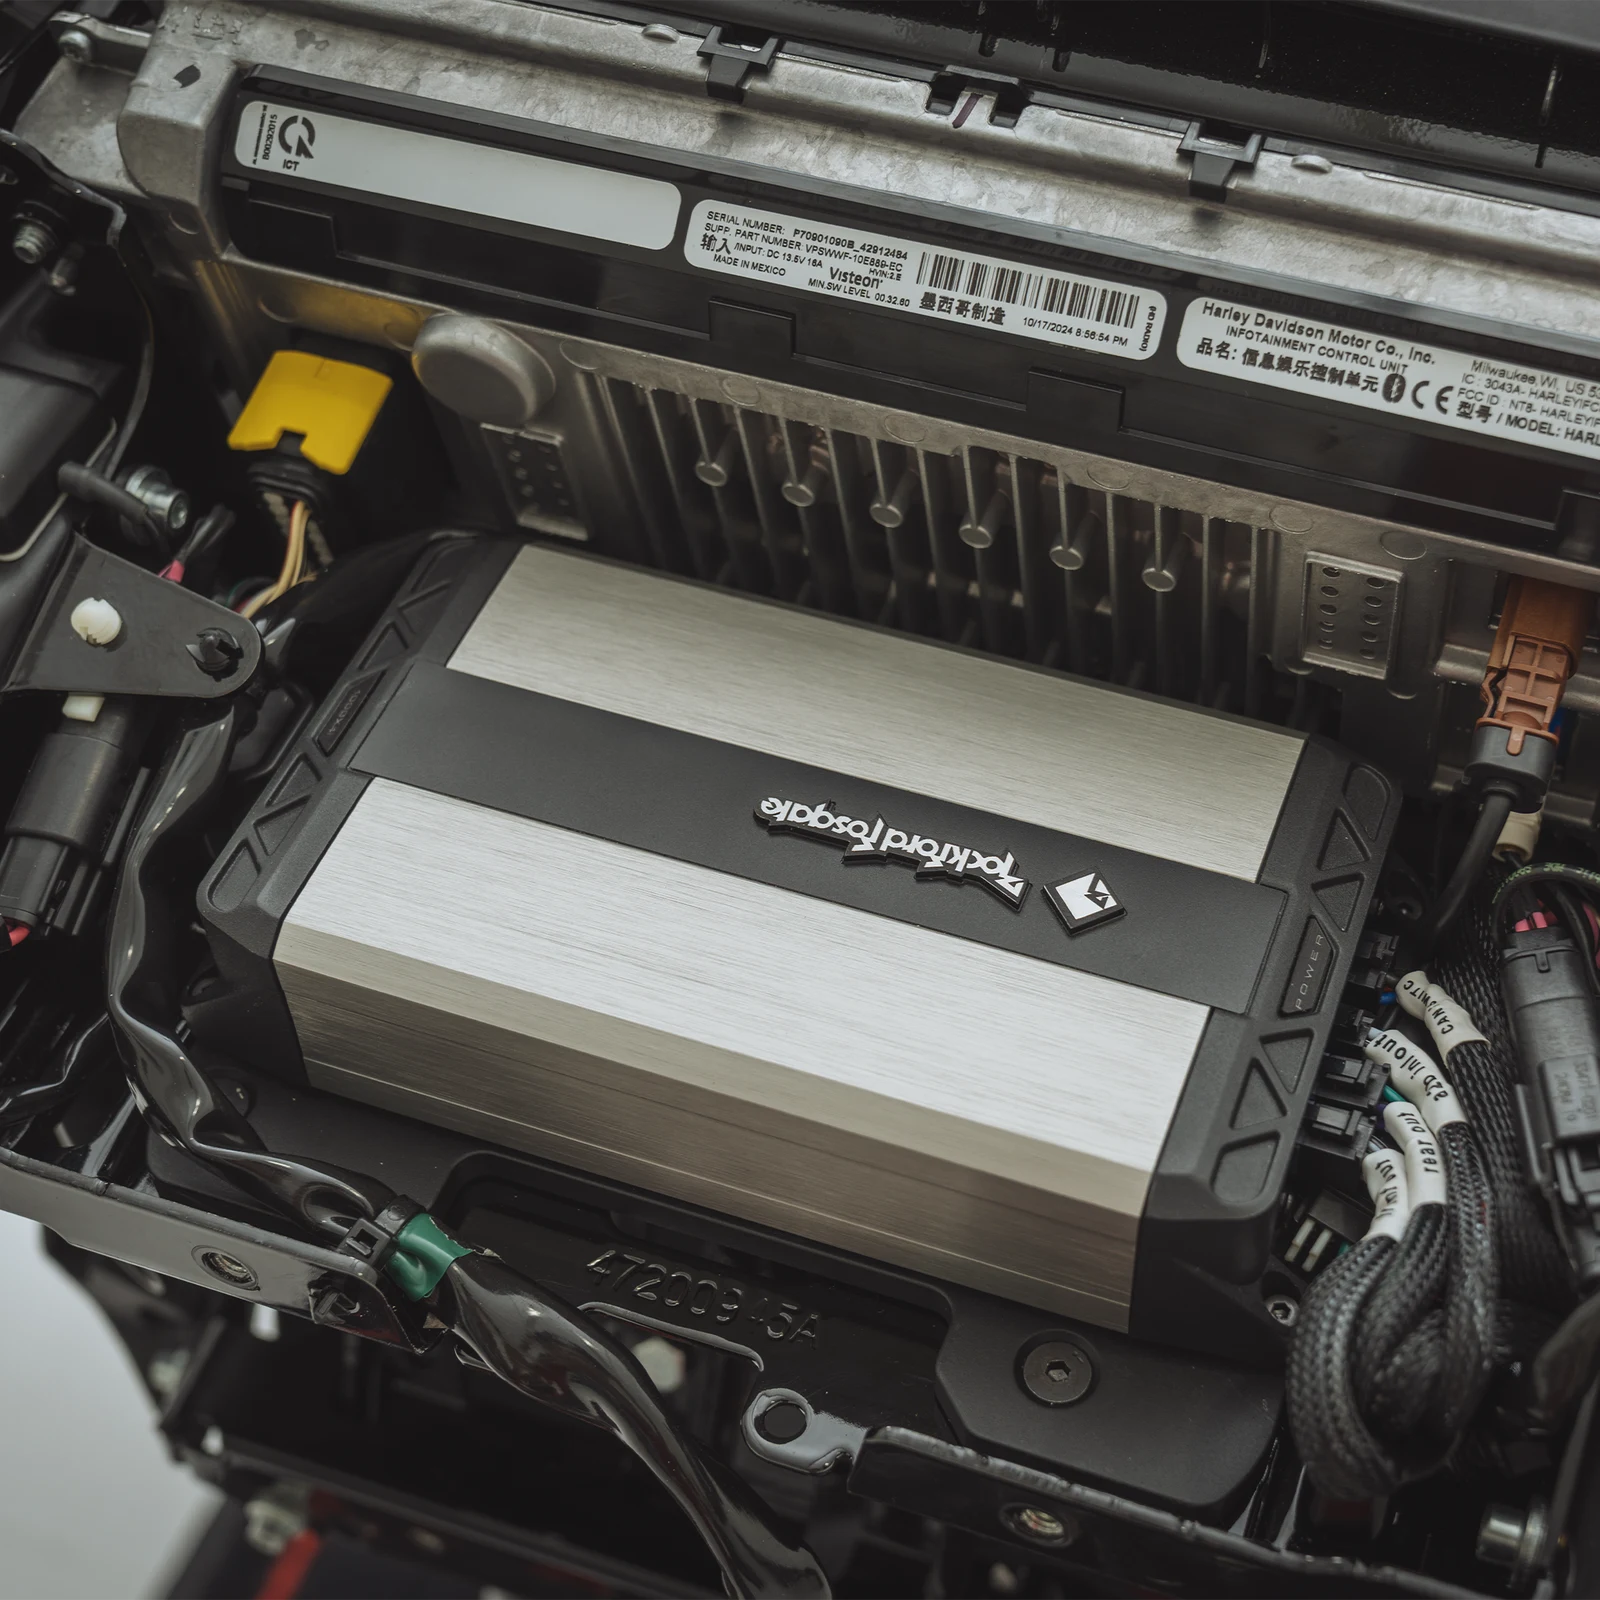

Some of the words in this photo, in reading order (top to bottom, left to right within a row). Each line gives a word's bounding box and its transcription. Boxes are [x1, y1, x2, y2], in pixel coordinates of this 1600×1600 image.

[283, 159, 300, 171] ICT
[707, 210, 740, 226] SERIAL
[742, 218, 785, 235] NUMBER:
[704, 223, 732, 237] SUPP.
[734, 229, 760, 242] PART
[761, 234, 803, 251] NUMBER:
[713, 254, 739, 267] MADE
[741, 259, 750, 269] IN
[750, 262, 786, 276] MEXICO
[766, 249, 780, 260] DC
[829, 266, 879, 289] Visteon
[843, 285, 871, 299] LEVEL
[919, 292, 1006, 325] 墨西哥制造
[1023, 317, 1073, 335] 10/17/2024
[1112, 335, 1129, 347] PM
[1203, 301, 1251, 326] Harley
[1254, 313, 1324, 340] Davidson
[1328, 329, 1371, 350] Motor
[1375, 339, 1403, 359] Co.,
[1408, 347, 1435, 365] Inc.
[1225, 325, 1315, 354] INFOTAINMENT
[1317, 346, 1375, 368] CONTROL
[1380, 359, 1408, 374] UNIT
[1457, 388, 1484, 402] FCC
[1487, 395, 1499, 406] ID
[1565, 380, 1585, 395] US
[1456, 400, 1492, 423] 型号
[1505, 415, 1561, 437] MODEL:
[1295, 934, 1323, 1012] POWER
[1397, 1111, 1426, 1135] out
[1418, 1138, 1439, 1173] rear
